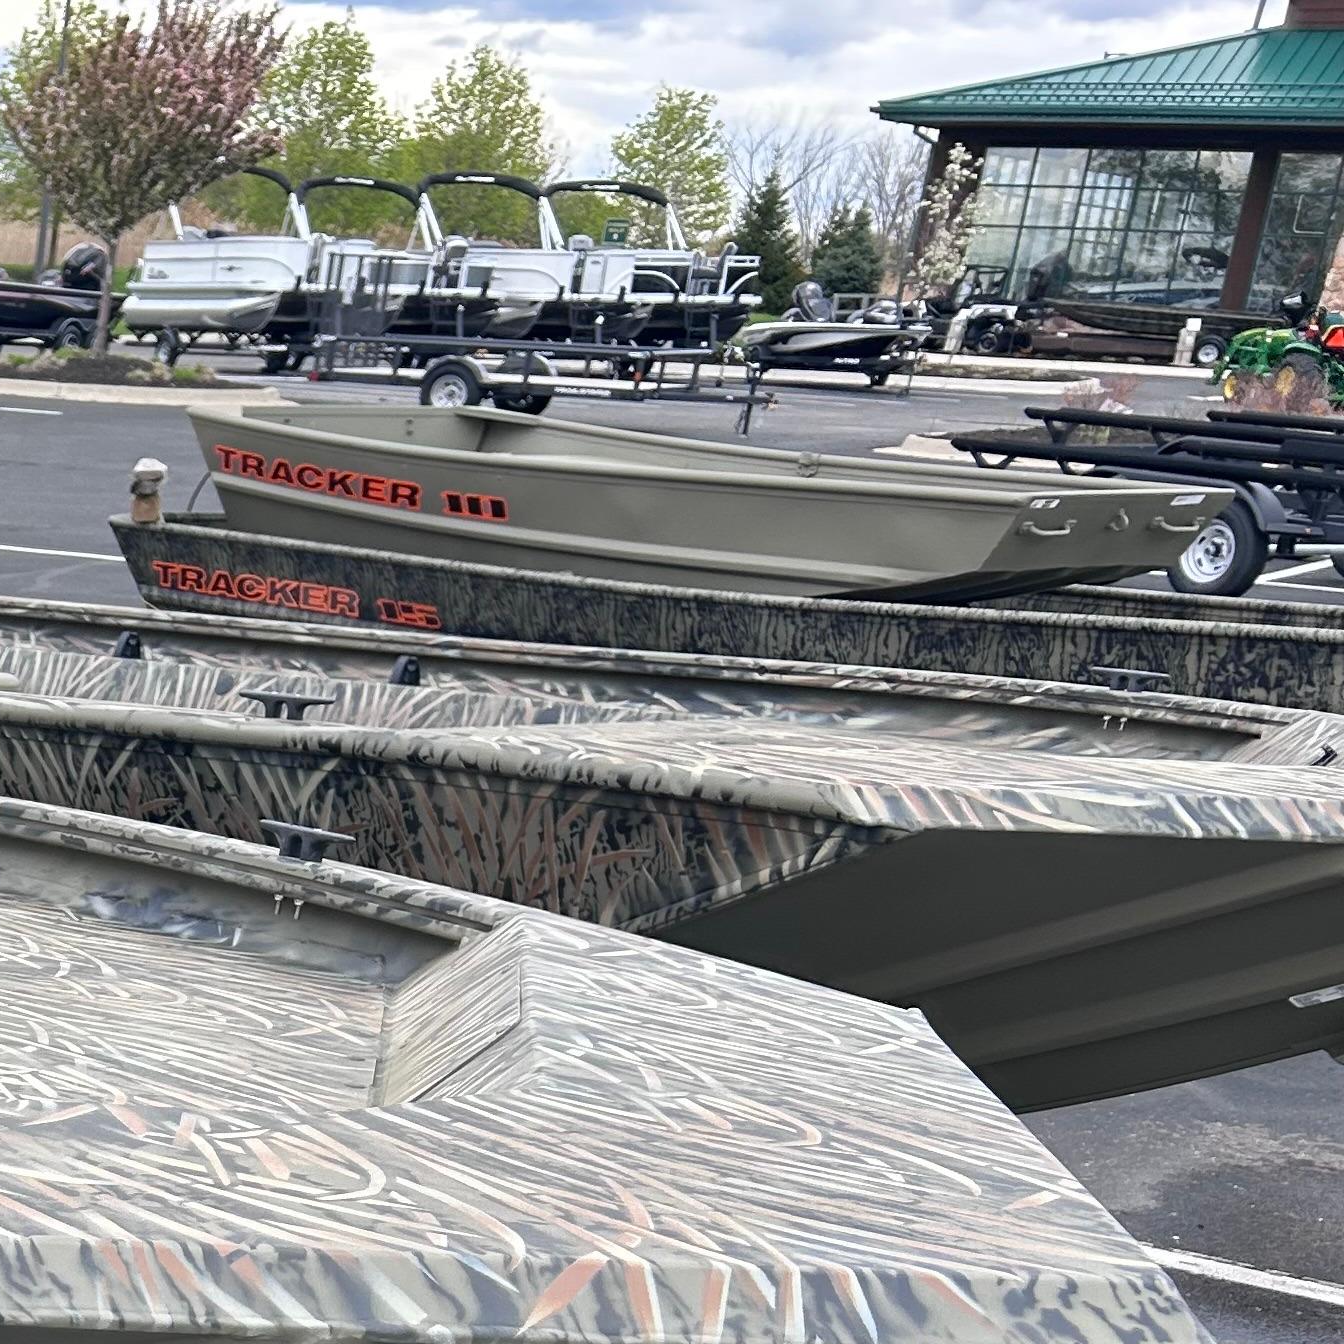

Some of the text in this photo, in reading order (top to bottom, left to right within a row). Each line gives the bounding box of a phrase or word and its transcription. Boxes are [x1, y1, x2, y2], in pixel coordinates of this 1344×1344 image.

[215, 443, 423, 511] TRACKER
[152, 559, 442, 630] TRACKER 15
